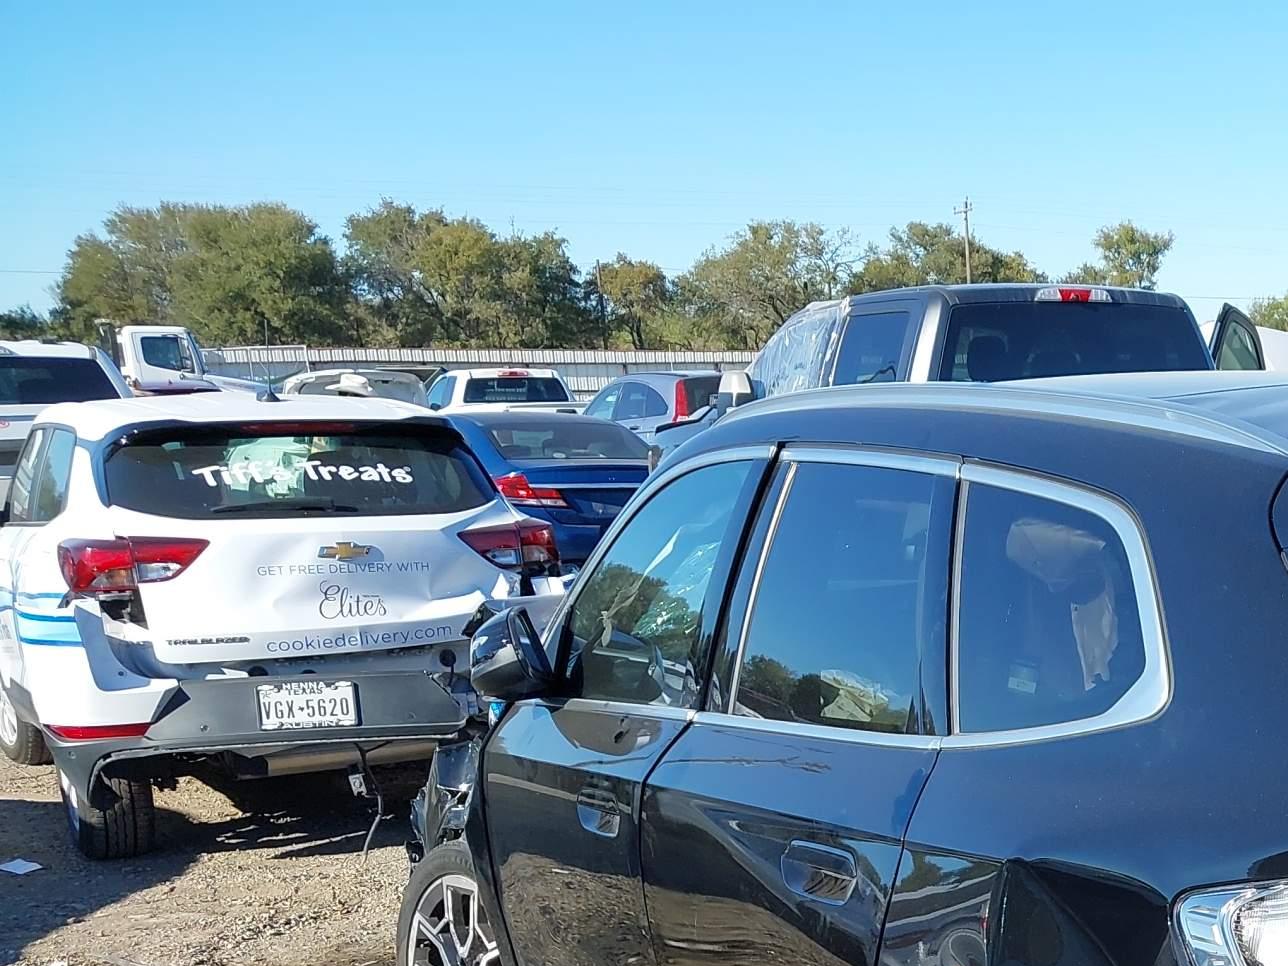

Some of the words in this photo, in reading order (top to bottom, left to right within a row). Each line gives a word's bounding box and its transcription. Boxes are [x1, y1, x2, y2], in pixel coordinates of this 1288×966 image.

[295, 460, 413, 483] Treats
[257, 565, 283, 577] GET
[289, 563, 325, 575] FREE
[328, 561, 393, 574] DELIVERY
[396, 561, 430, 572] WITH
[319, 580, 387, 619] Elites
[266, 625, 452, 653] cookiedelivery.com
[282, 681, 326, 690] HENNA
[287, 688, 323, 696] TEXAS
